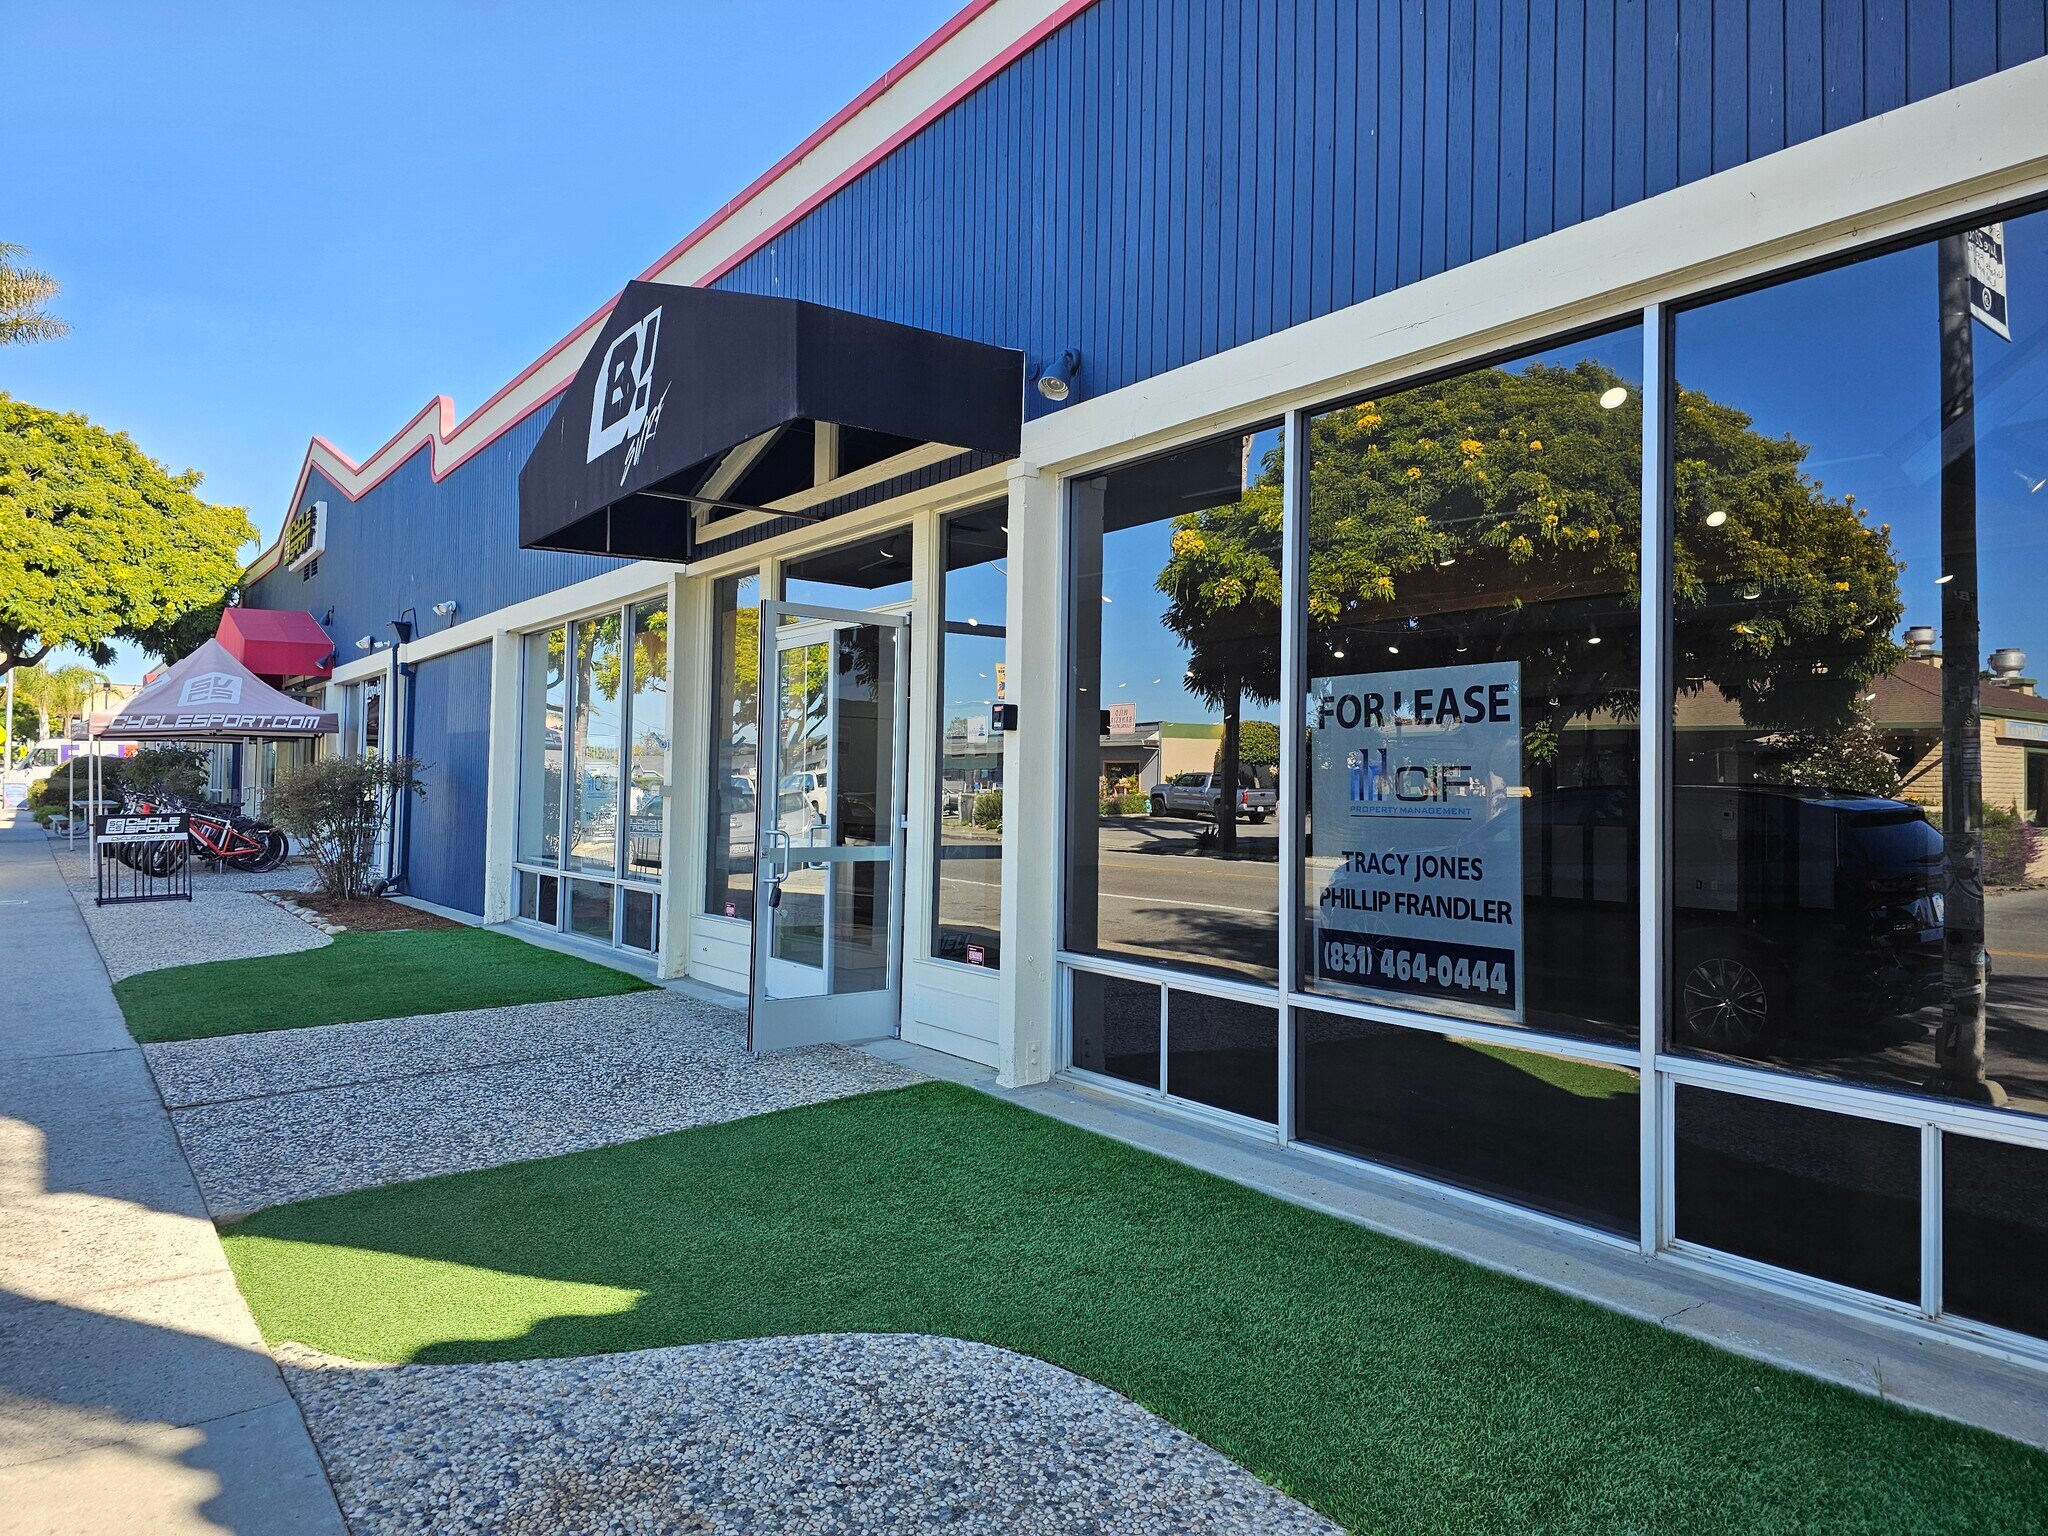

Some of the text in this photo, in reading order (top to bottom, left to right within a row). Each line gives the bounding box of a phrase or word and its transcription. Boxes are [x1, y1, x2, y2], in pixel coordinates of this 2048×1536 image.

[108, 714, 320, 730] CYCLESPORT.COM
[1319, 683, 1511, 730] FOR LEASE
[1395, 765, 1472, 802] CIF
[125, 817, 181, 825] CYCLE
[1350, 805, 1472, 816] PROPERTY MANAGEMENT
[124, 825, 180, 833] SPORT
[1341, 851, 1484, 883] TRACY JONES
[1319, 887, 1513, 925] PHILLIP FRANDLER
[1323, 941, 1508, 995] (831) 464-0444
